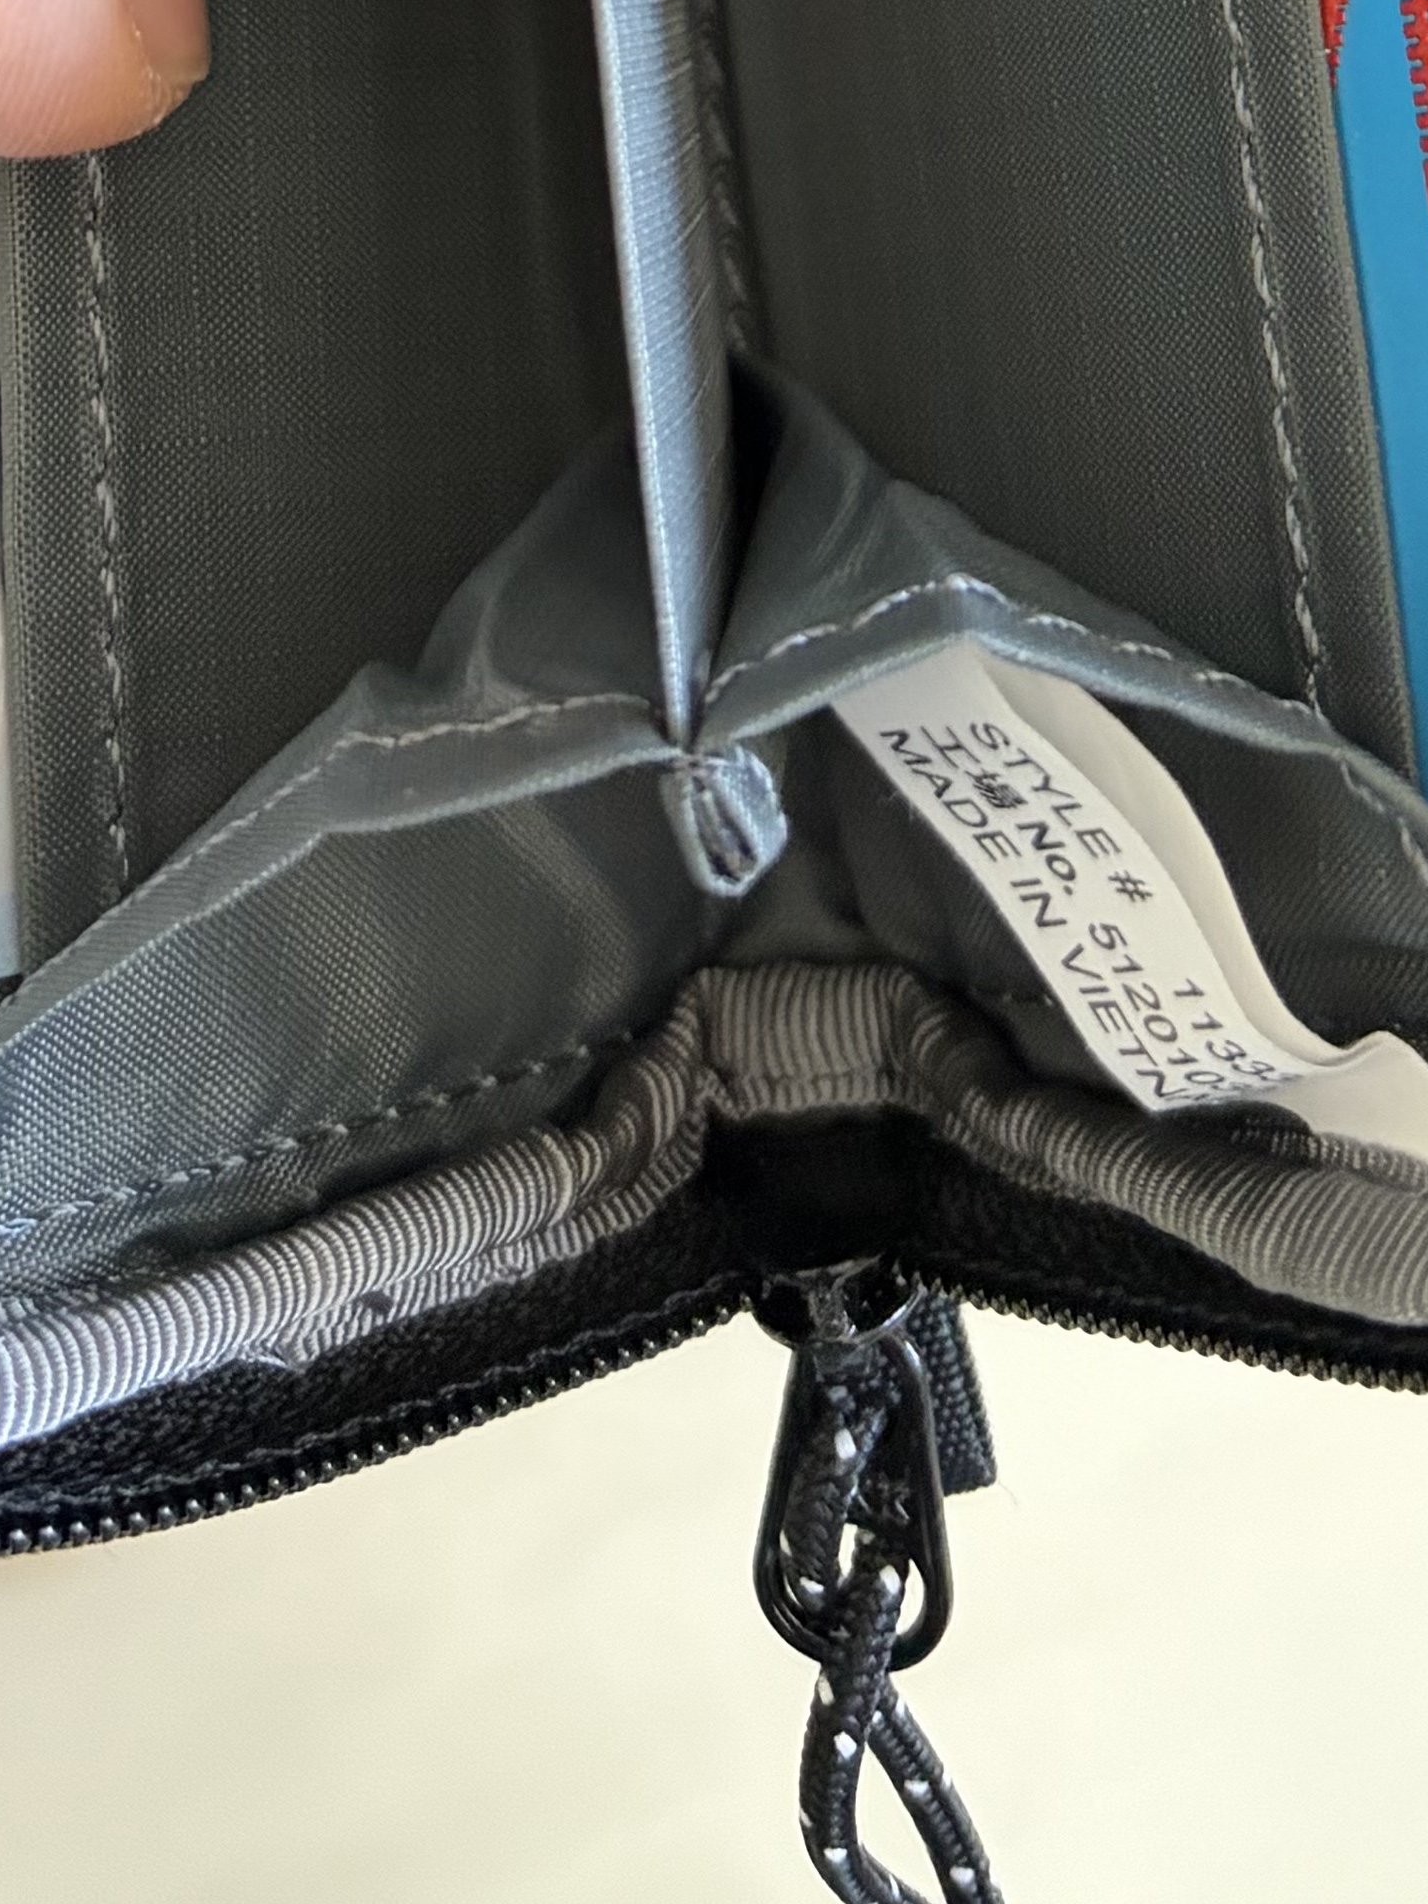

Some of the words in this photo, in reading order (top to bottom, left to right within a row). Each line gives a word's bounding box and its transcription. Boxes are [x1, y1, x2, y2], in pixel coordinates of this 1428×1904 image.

[880, 729, 1019, 861] MADE
[1010, 878, 1067, 929] IN
[920, 726, 1024, 809] 工場
[1017, 822, 1079, 897] No.
[972, 723, 1122, 860] STYLE
[1109, 870, 1153, 904] #
